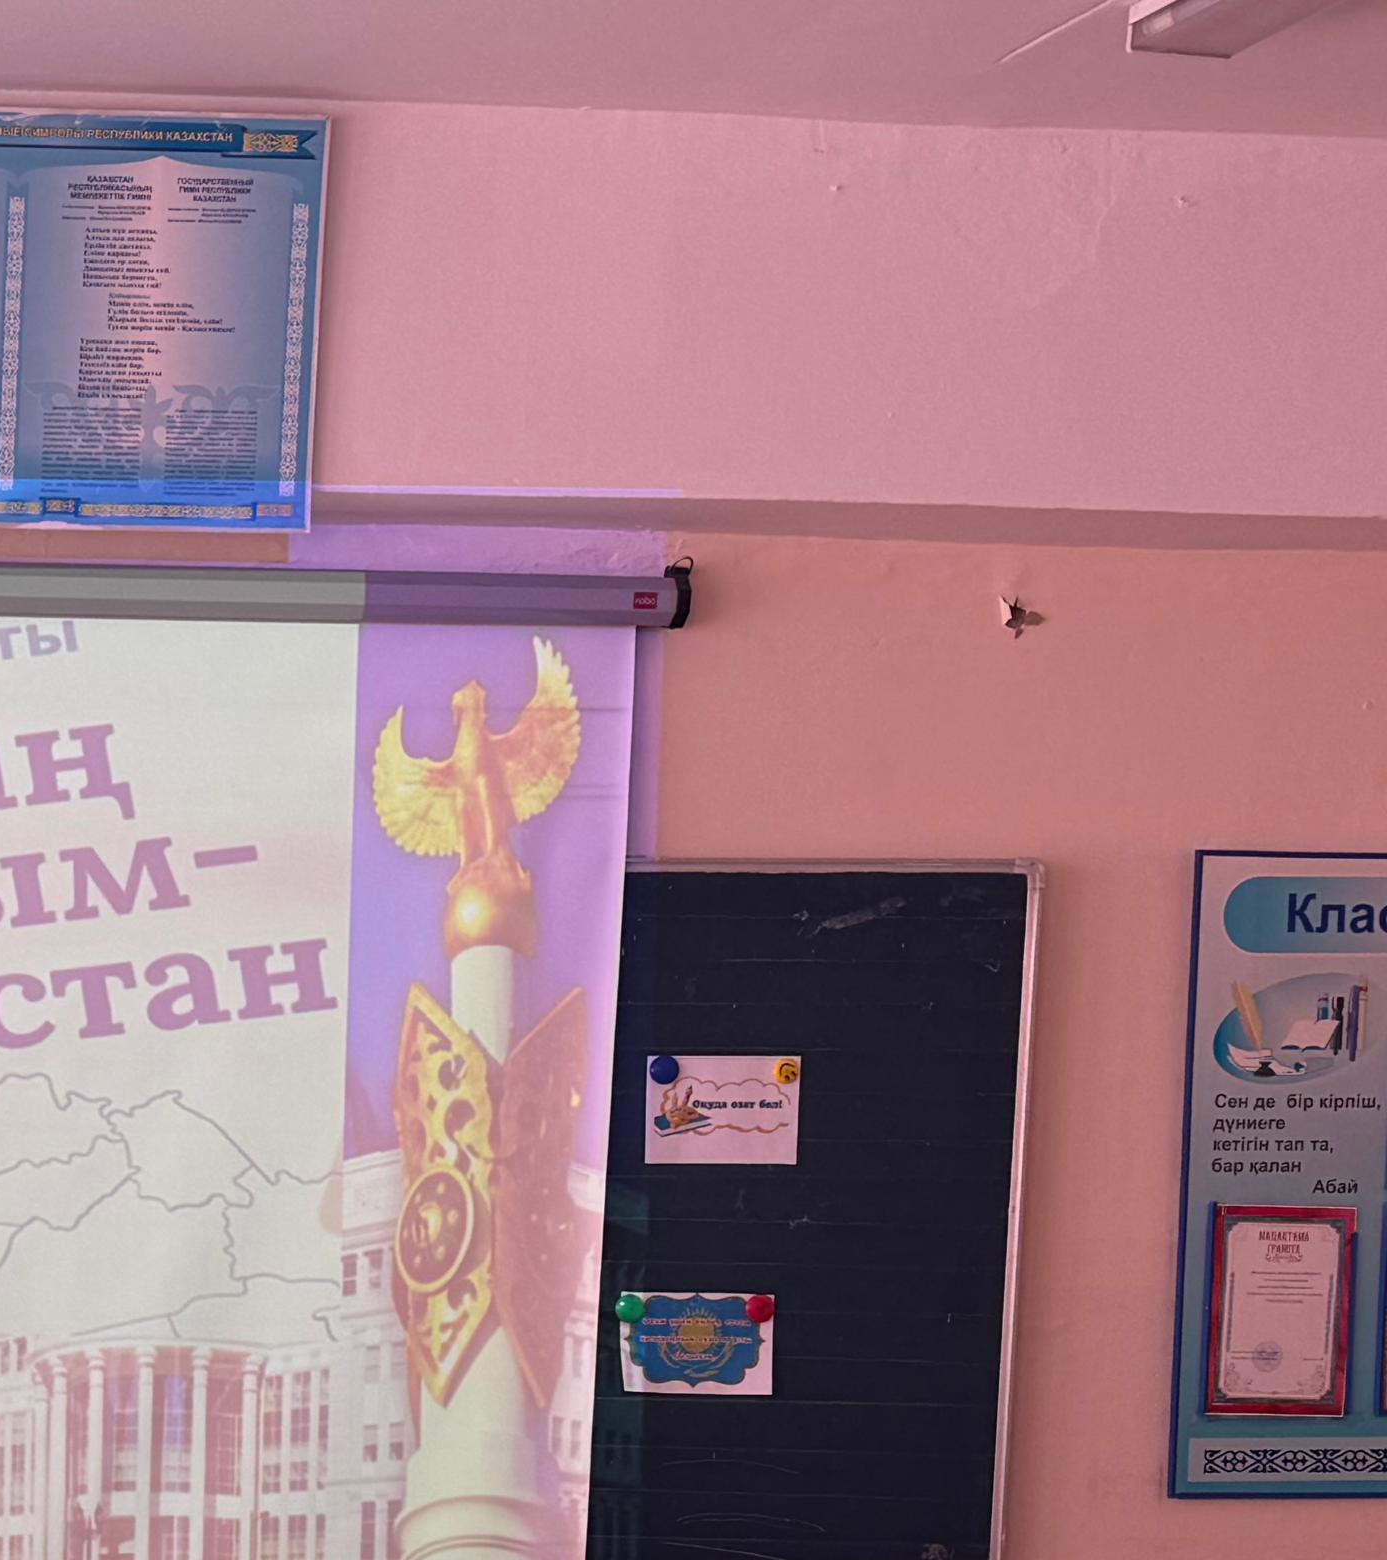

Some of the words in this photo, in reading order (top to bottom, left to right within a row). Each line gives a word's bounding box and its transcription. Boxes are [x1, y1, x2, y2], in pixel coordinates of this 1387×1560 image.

[24, 127, 84, 139] СИМВОЛЫ
[86, 128, 163, 140] РЕСПУБЛИКИ
[166, 130, 233, 142] КАЗАХСТАН
[177, 177, 254, 187] ГОСУДАРСТВЕННЫЙ
[202, 187, 252, 195] РЕСПУБЛИКИ
[192, 195, 237, 203] КАЗАХСТАН
[1214, 1093, 1248, 1109] Сен
[1253, 1096, 1276, 1111] де
[1286, 1093, 1314, 1112] бір
[1319, 1093, 1382, 1112] кірпіш,
[1212, 1118, 1286, 1133] дүниеге
[1212, 1136, 1269, 1152] кетігін
[1274, 1139, 1305, 1152] тап
[1310, 1139, 1334, 1153] та,
[1211, 1157, 1244, 1175] бар
[1249, 1160, 1302, 1175] қалан
[1312, 1178, 1359, 1194] Абай
